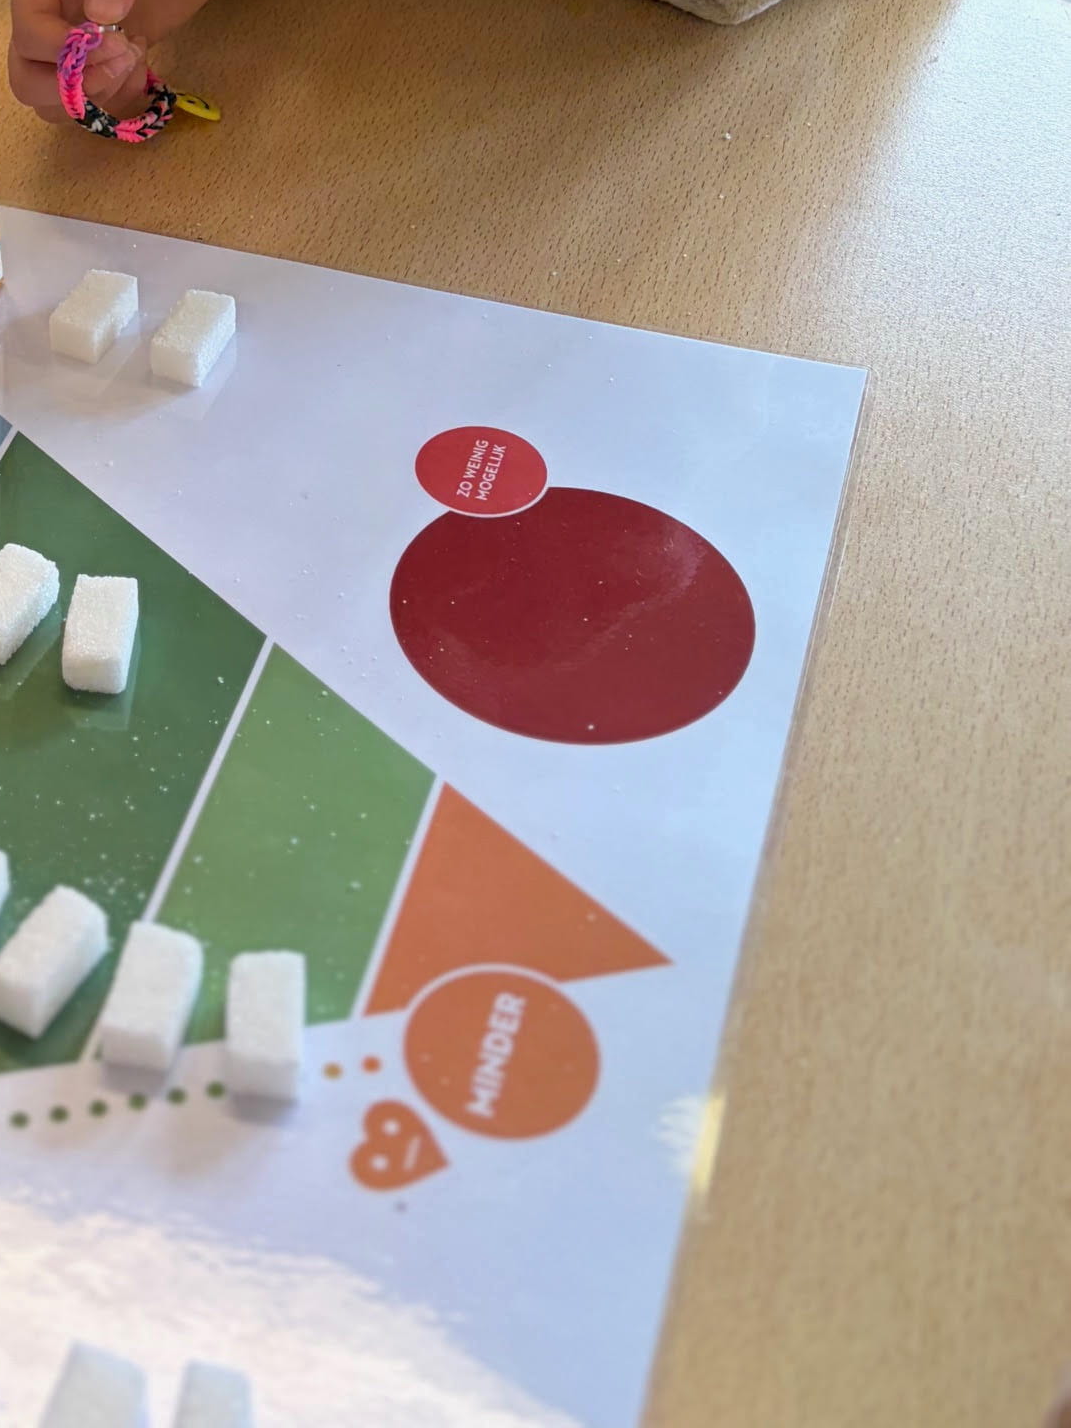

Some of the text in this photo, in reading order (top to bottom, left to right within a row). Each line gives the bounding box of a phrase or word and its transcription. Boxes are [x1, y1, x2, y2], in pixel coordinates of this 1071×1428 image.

[456, 439, 490, 498] ZO WEINIG
[474, 444, 507, 501] MOGELIJK
[465, 991, 527, 1119] MINDER
